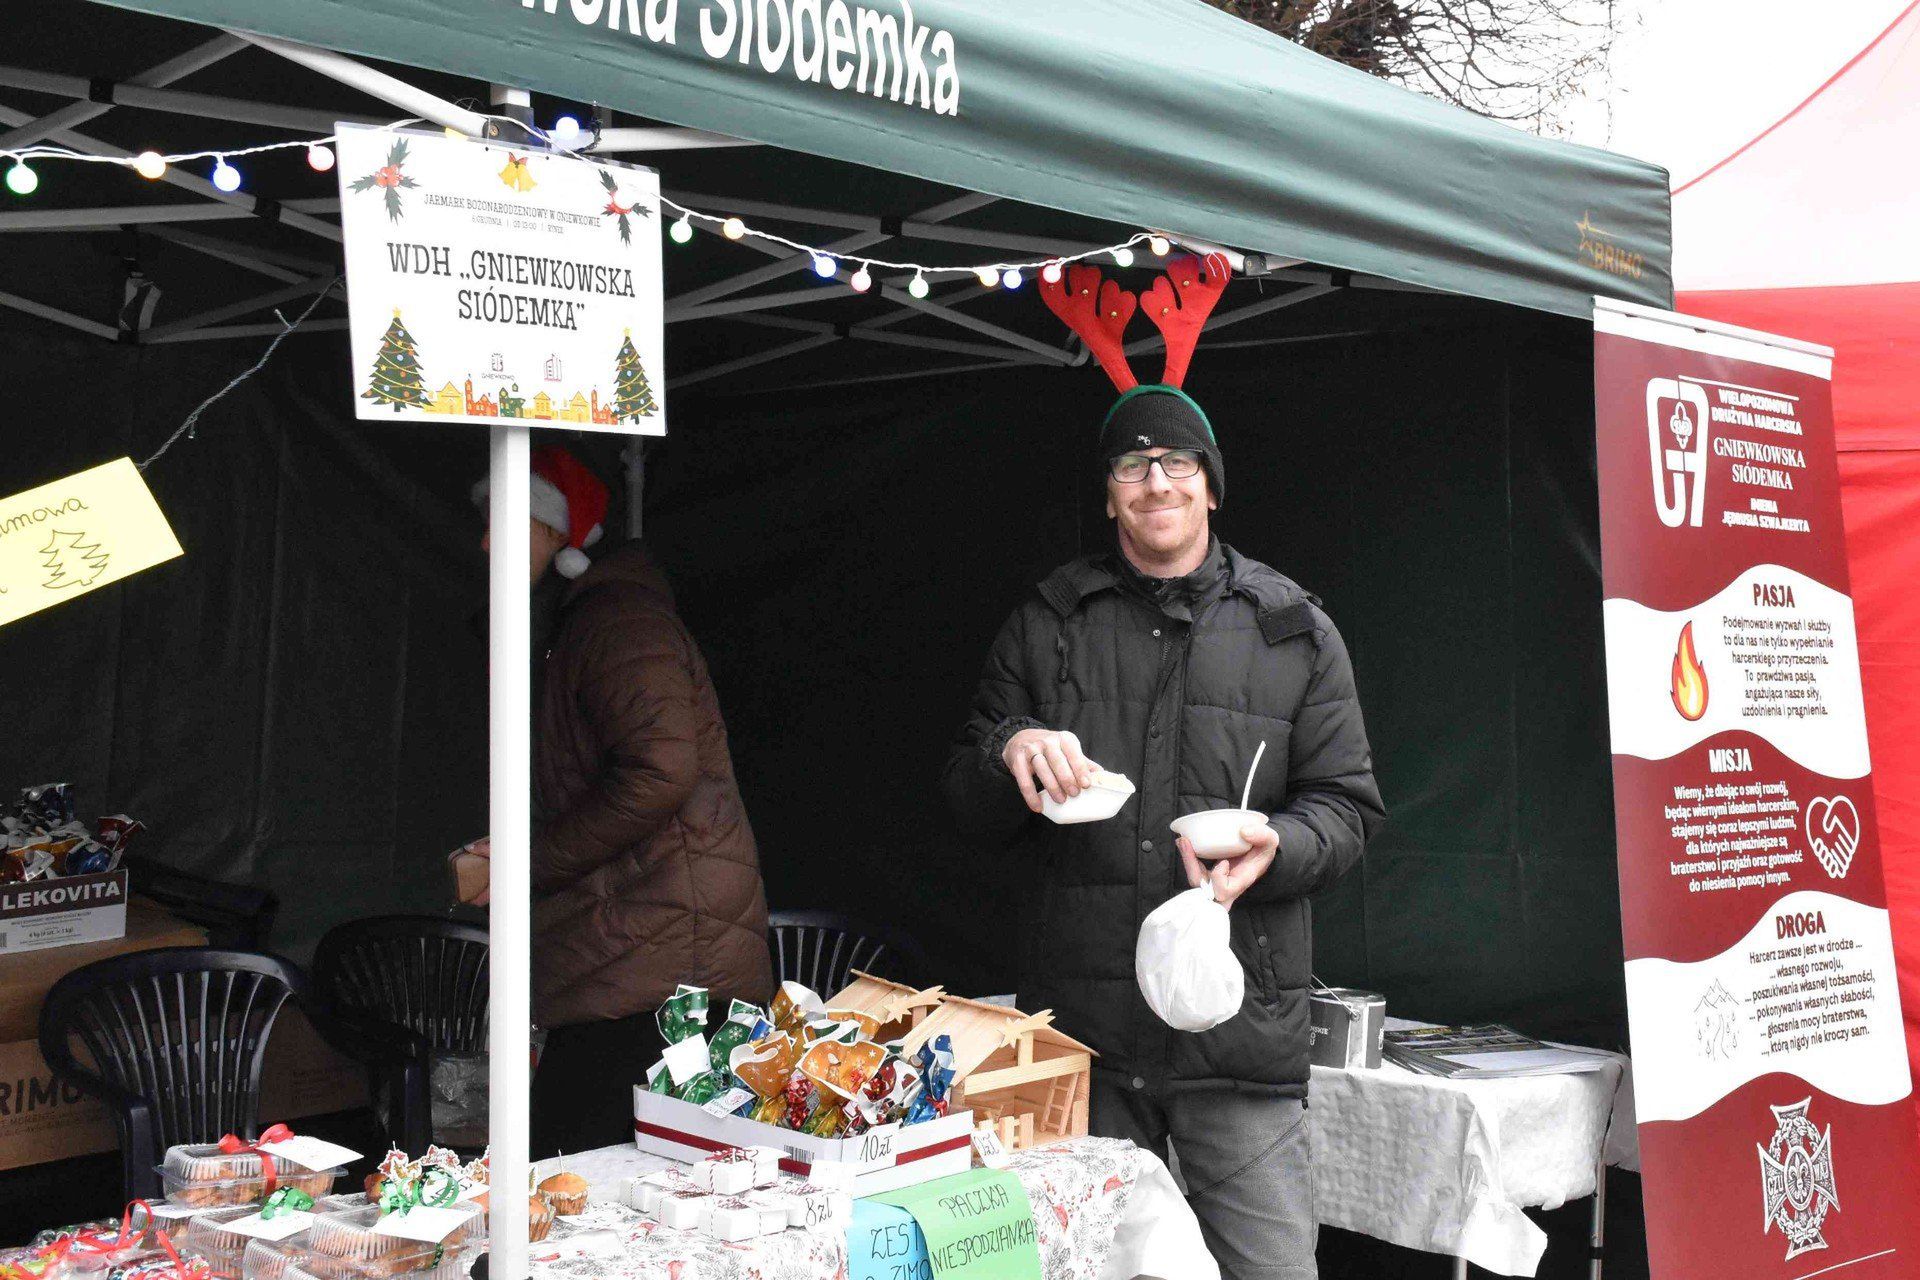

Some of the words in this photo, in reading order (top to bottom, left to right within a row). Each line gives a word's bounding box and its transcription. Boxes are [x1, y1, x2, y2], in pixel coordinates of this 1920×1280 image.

[424, 193, 465, 208] JARMARK
[466, 197, 549, 219] BOŻONARODZENIOWY
[549, 209, 556, 220] W
[556, 210, 602, 227] GNIEWKOWIE
[387, 242, 452, 277] WDH
[1711, 406, 1754, 427] DRUŻYNA
[1754, 414, 1803, 435] HARCERSKA
[1714, 437, 1806, 468] GNIEWKOWSKA
[1732, 461, 1793, 490] SIÓDEMKA
[1753, 584, 1795, 608] PASJA
[1723, 616, 1773, 632] Podejmowanie
[1775, 620, 1802, 634] wyzwań
[1804, 622, 1806, 630] i
[1807, 621, 1831, 634] służby
[1724, 635, 1732, 645] to
[1733, 634, 1744, 646] dla
[1746, 637, 1758, 646] nas
[1759, 636, 1769, 647] nie
[1771, 635, 1789, 650] tylko
[1790, 636, 1834, 652] wypełnianie
[1732, 652, 1776, 667] harcerskiego
[1777, 655, 1828, 667] przyrzeczenia.
[1745, 669, 1753, 681] To
[1756, 670, 1793, 684] prawdziwa
[1795, 672, 1816, 684] pasja,
[1745, 688, 1783, 702] angażująca
[1784, 689, 1805, 699] nasze
[1742, 705, 1782, 717] uzdolnienia
[1783, 706, 1786, 716] i
[1787, 705, 1828, 719] pragnienia.
[1709, 748, 1753, 773] MISJA
[1674, 786, 1704, 801] Wiemy,
[1705, 785, 1714, 798] że
[1715, 785, 1739, 800] dbając
[1740, 787, 1744, 795] o
[1745, 783, 1762, 797] swój
[1763, 781, 1789, 796] rozwój,
[1665, 805, 1692, 822] będąc
[1693, 803, 1728, 819] wiernymi
[1757, 799, 1799, 813] harcerskim,
[1672, 825, 1705, 839] stajemy
[1706, 822, 1717, 836] się
[1718, 822, 1737, 833] coraz
[1738, 818, 1770, 835] lepszymi
[1686, 843, 1699, 855] dla
[1700, 839, 1730, 856] których
[1731, 838, 1778, 853] najważniejsze
[1779, 836, 1788, 849] są
[1670, 859, 1716, 876] braterstwo
[1717, 858, 1720, 871] i
[1722, 855, 1751, 873] przyjaźń
[1753, 856, 1768, 867] oraz
[1769, 850, 1803, 868] gotowość
[1689, 879, 1700, 893] do
[1702, 876, 1736, 891] niesienia
[1737, 874, 1765, 889] pomocy
[1766, 872, 1791, 886] innym.
[1776, 911, 1826, 939] DROGA
[1750, 950, 1777, 964] Harcerz
[1778, 946, 1802, 959] zawsze
[1803, 944, 1817, 958] jest
[1819, 944, 1825, 953] w
[1826, 938, 1854, 952] drodze
[1776, 964, 1809, 979] własnego
[1811, 959, 1844, 974] rozwoju,
[1752, 985, 1799, 1003] poszukiwania
[1800, 978, 1828, 993] własnej
[1829, 969, 1875, 987] tożsamości,
[1757, 1001, 1803, 1020] pokonywania
[1804, 993, 1839, 1009] własnych
[1840, 988, 1875, 1003] słabości,
[1767, 1021, 1800, 1038] głoszenia
[1801, 1016, 1821, 1030] mocy
[1822, 1007, 1867, 1023] braterstwa,
[1771, 1038, 1789, 1054] którą
[1790, 1034, 1810, 1050] nigdy
[1811, 1034, 1823, 1044] nie
[1824, 1029, 1849, 1043] kroczy
[1851, 1025, 1870, 1037] sam.
[859, 1134, 893, 1163] 10zł
[938, 1183, 1010, 1219] PACZKA
[931, 1218, 1036, 1275] NIESPODZIANKA
